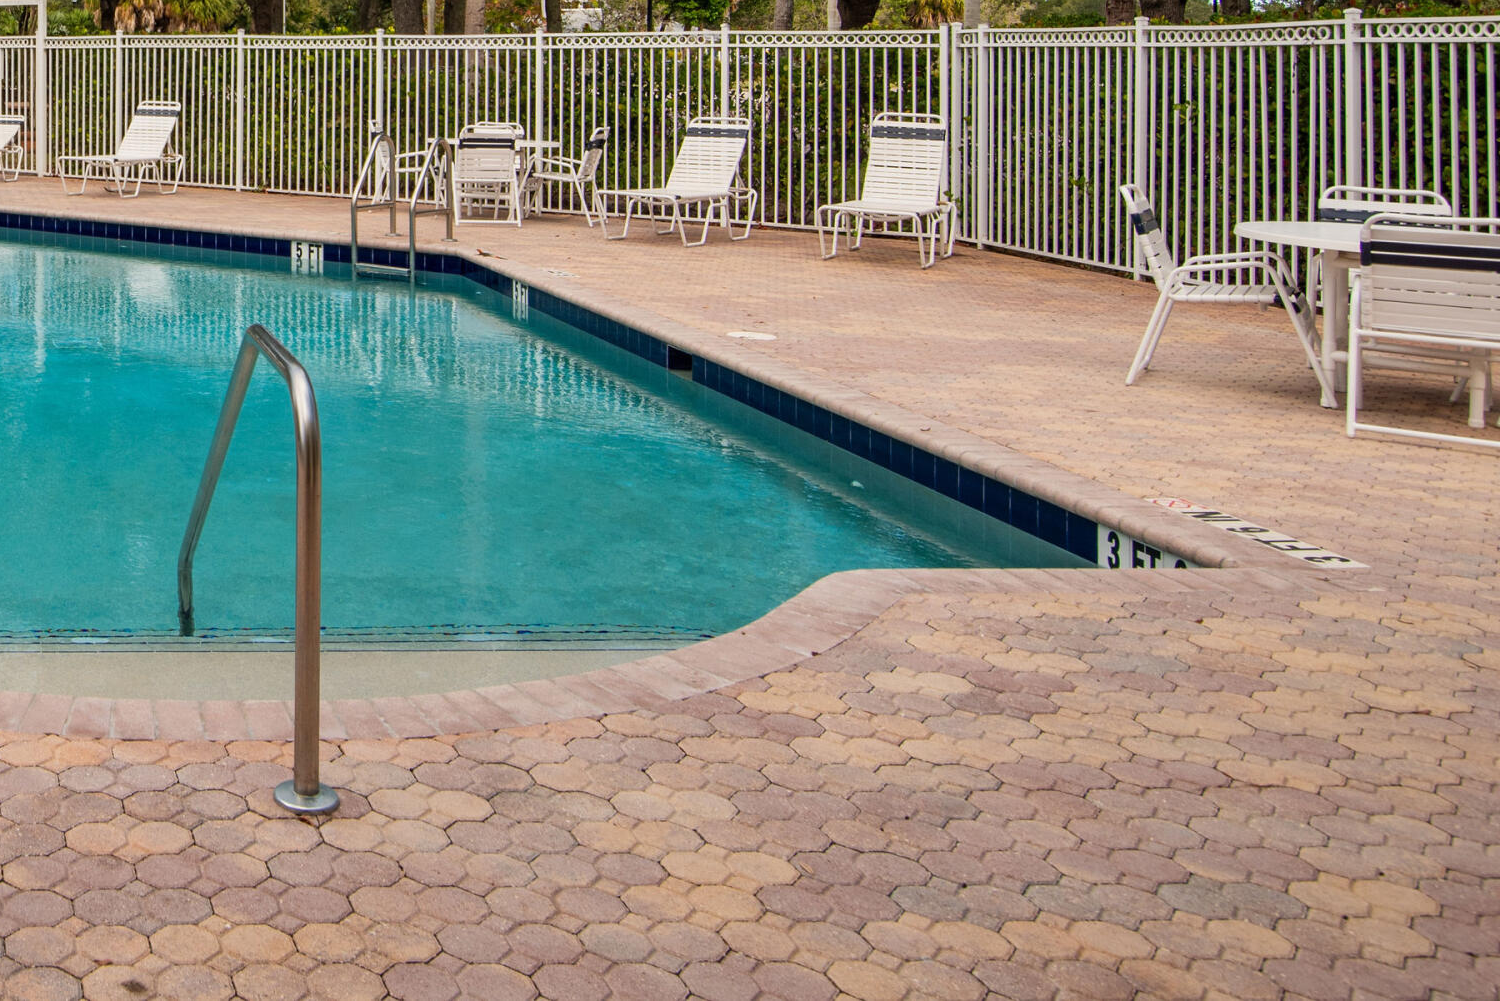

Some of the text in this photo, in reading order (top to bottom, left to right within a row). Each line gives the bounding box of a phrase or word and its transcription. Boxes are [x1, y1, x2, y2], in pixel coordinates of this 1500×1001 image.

[296, 242, 322, 260] 5 FT
[1181, 511, 1243, 522] IN
[1107, 530, 1161, 569] 3 FT
[1252, 538, 1323, 551] FT
[1303, 555, 1351, 563] 3
